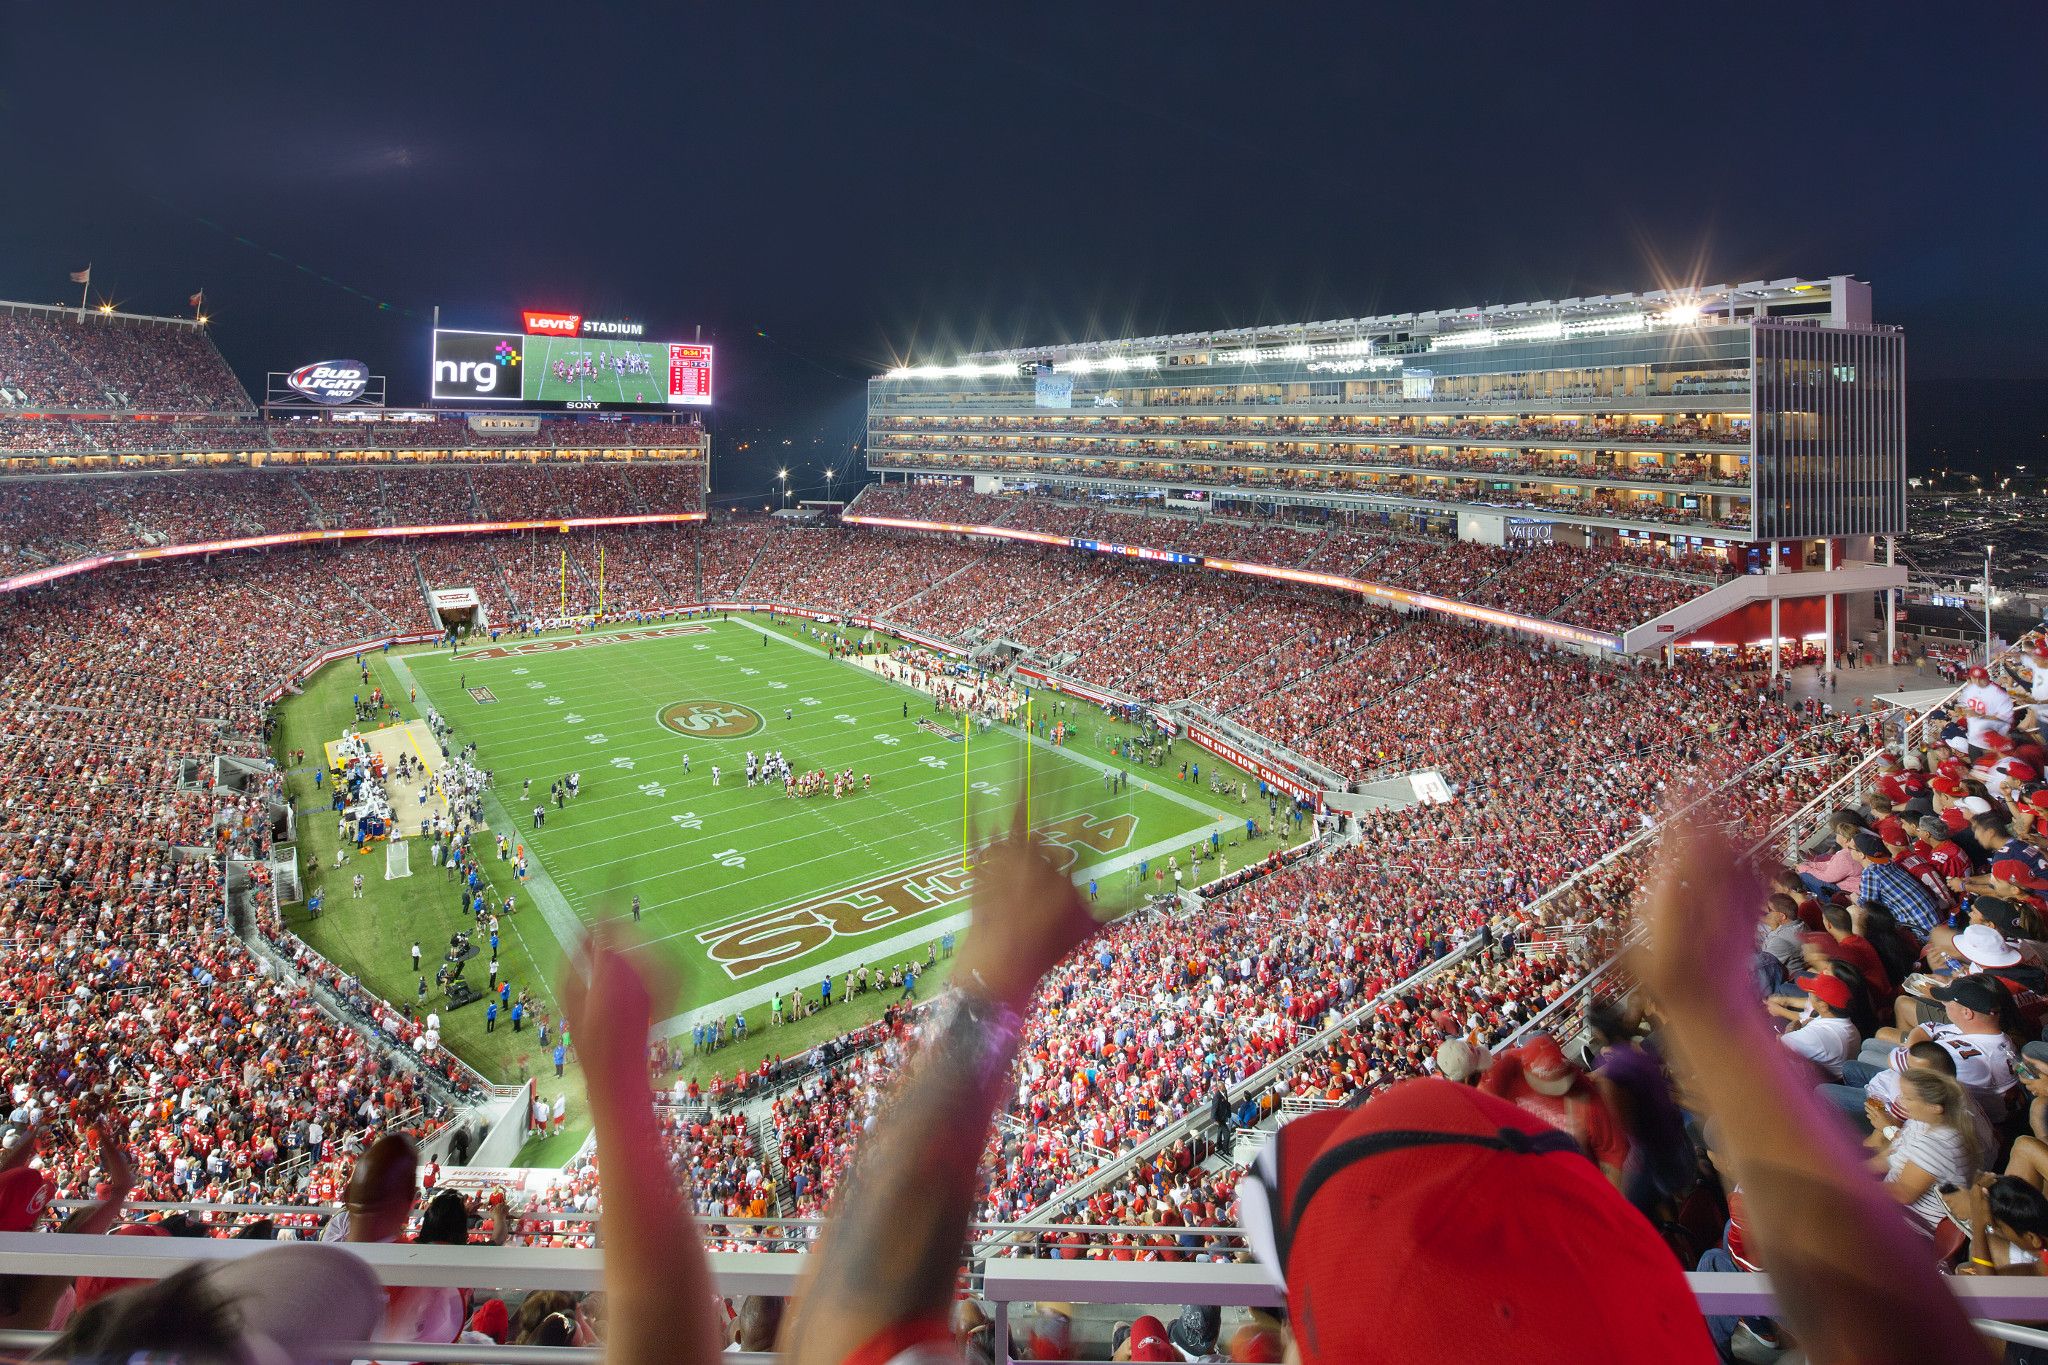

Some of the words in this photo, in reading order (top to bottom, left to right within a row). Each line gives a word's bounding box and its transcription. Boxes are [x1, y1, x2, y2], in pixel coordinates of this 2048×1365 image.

[583, 321, 643, 335] STADIUM
[310, 367, 361, 380] BUD
[436, 360, 497, 392] nrg
[299, 379, 367, 389] LIGHT
[566, 401, 601, 409] SONY
[1509, 524, 1552, 540] YAHOO!
[774, 605, 789, 613] HOME
[1190, 729, 1213, 748] 5-TIME
[1214, 740, 1236, 761] SUPER
[1260, 768, 1311, 802] CHAMPIONS
[670, 811, 703, 829] 20
[711, 848, 747, 867] 10
